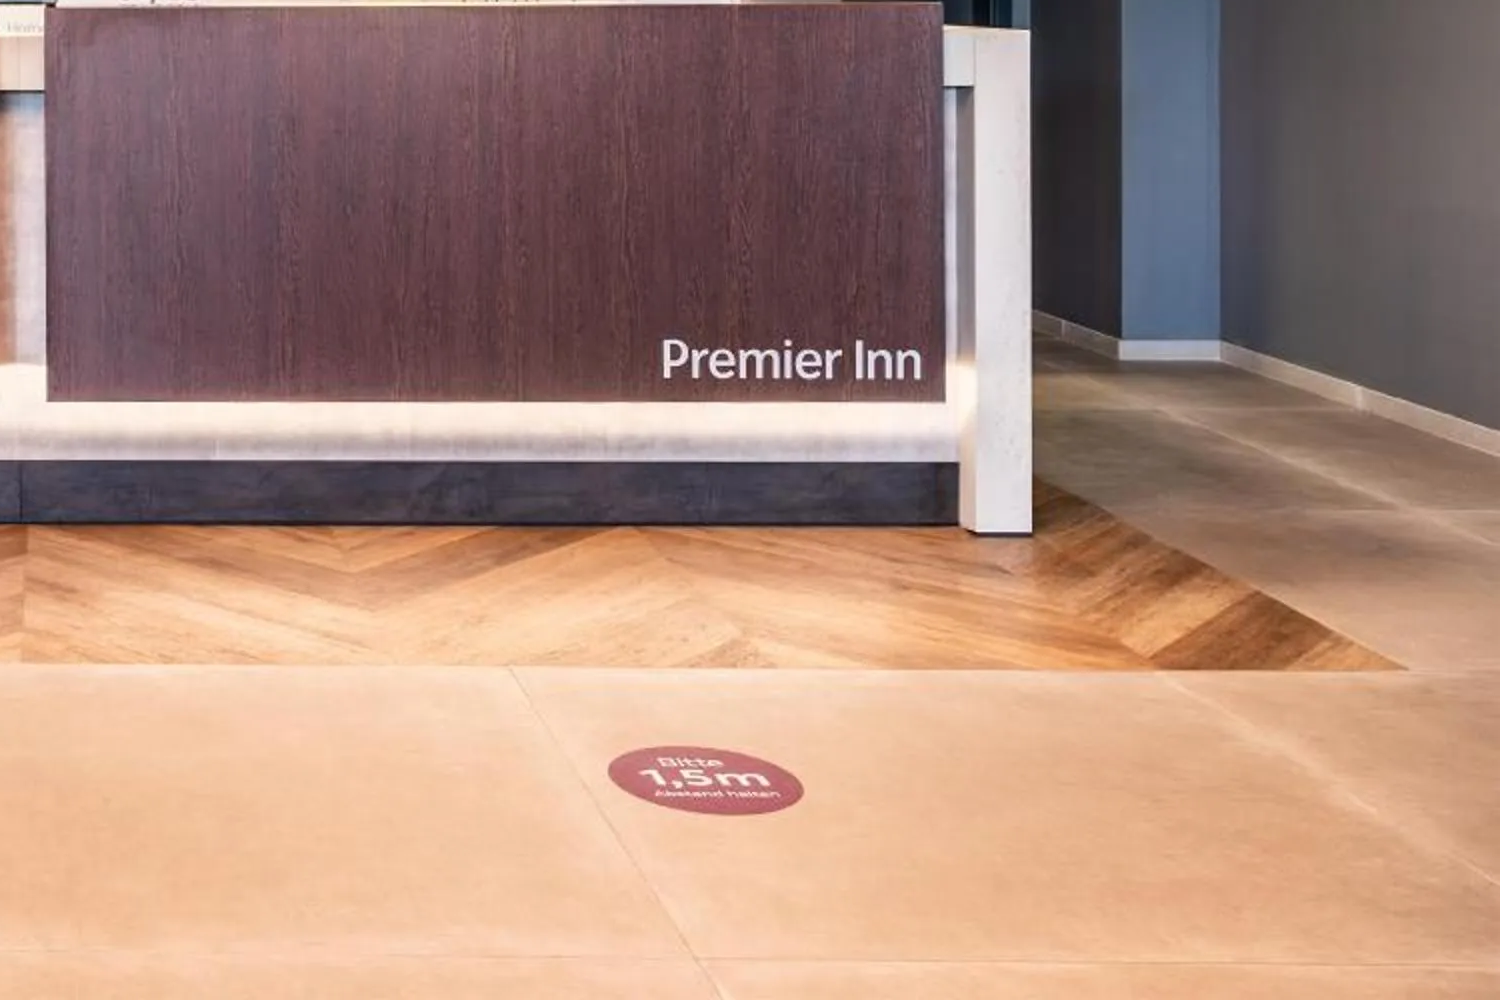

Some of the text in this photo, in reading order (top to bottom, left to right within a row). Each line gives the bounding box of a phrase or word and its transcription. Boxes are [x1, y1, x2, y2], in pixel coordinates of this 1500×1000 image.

[662, 339, 922, 380] Premier Inn
[656, 756, 724, 769] Bitte
[638, 769, 771, 789] 1,5m
